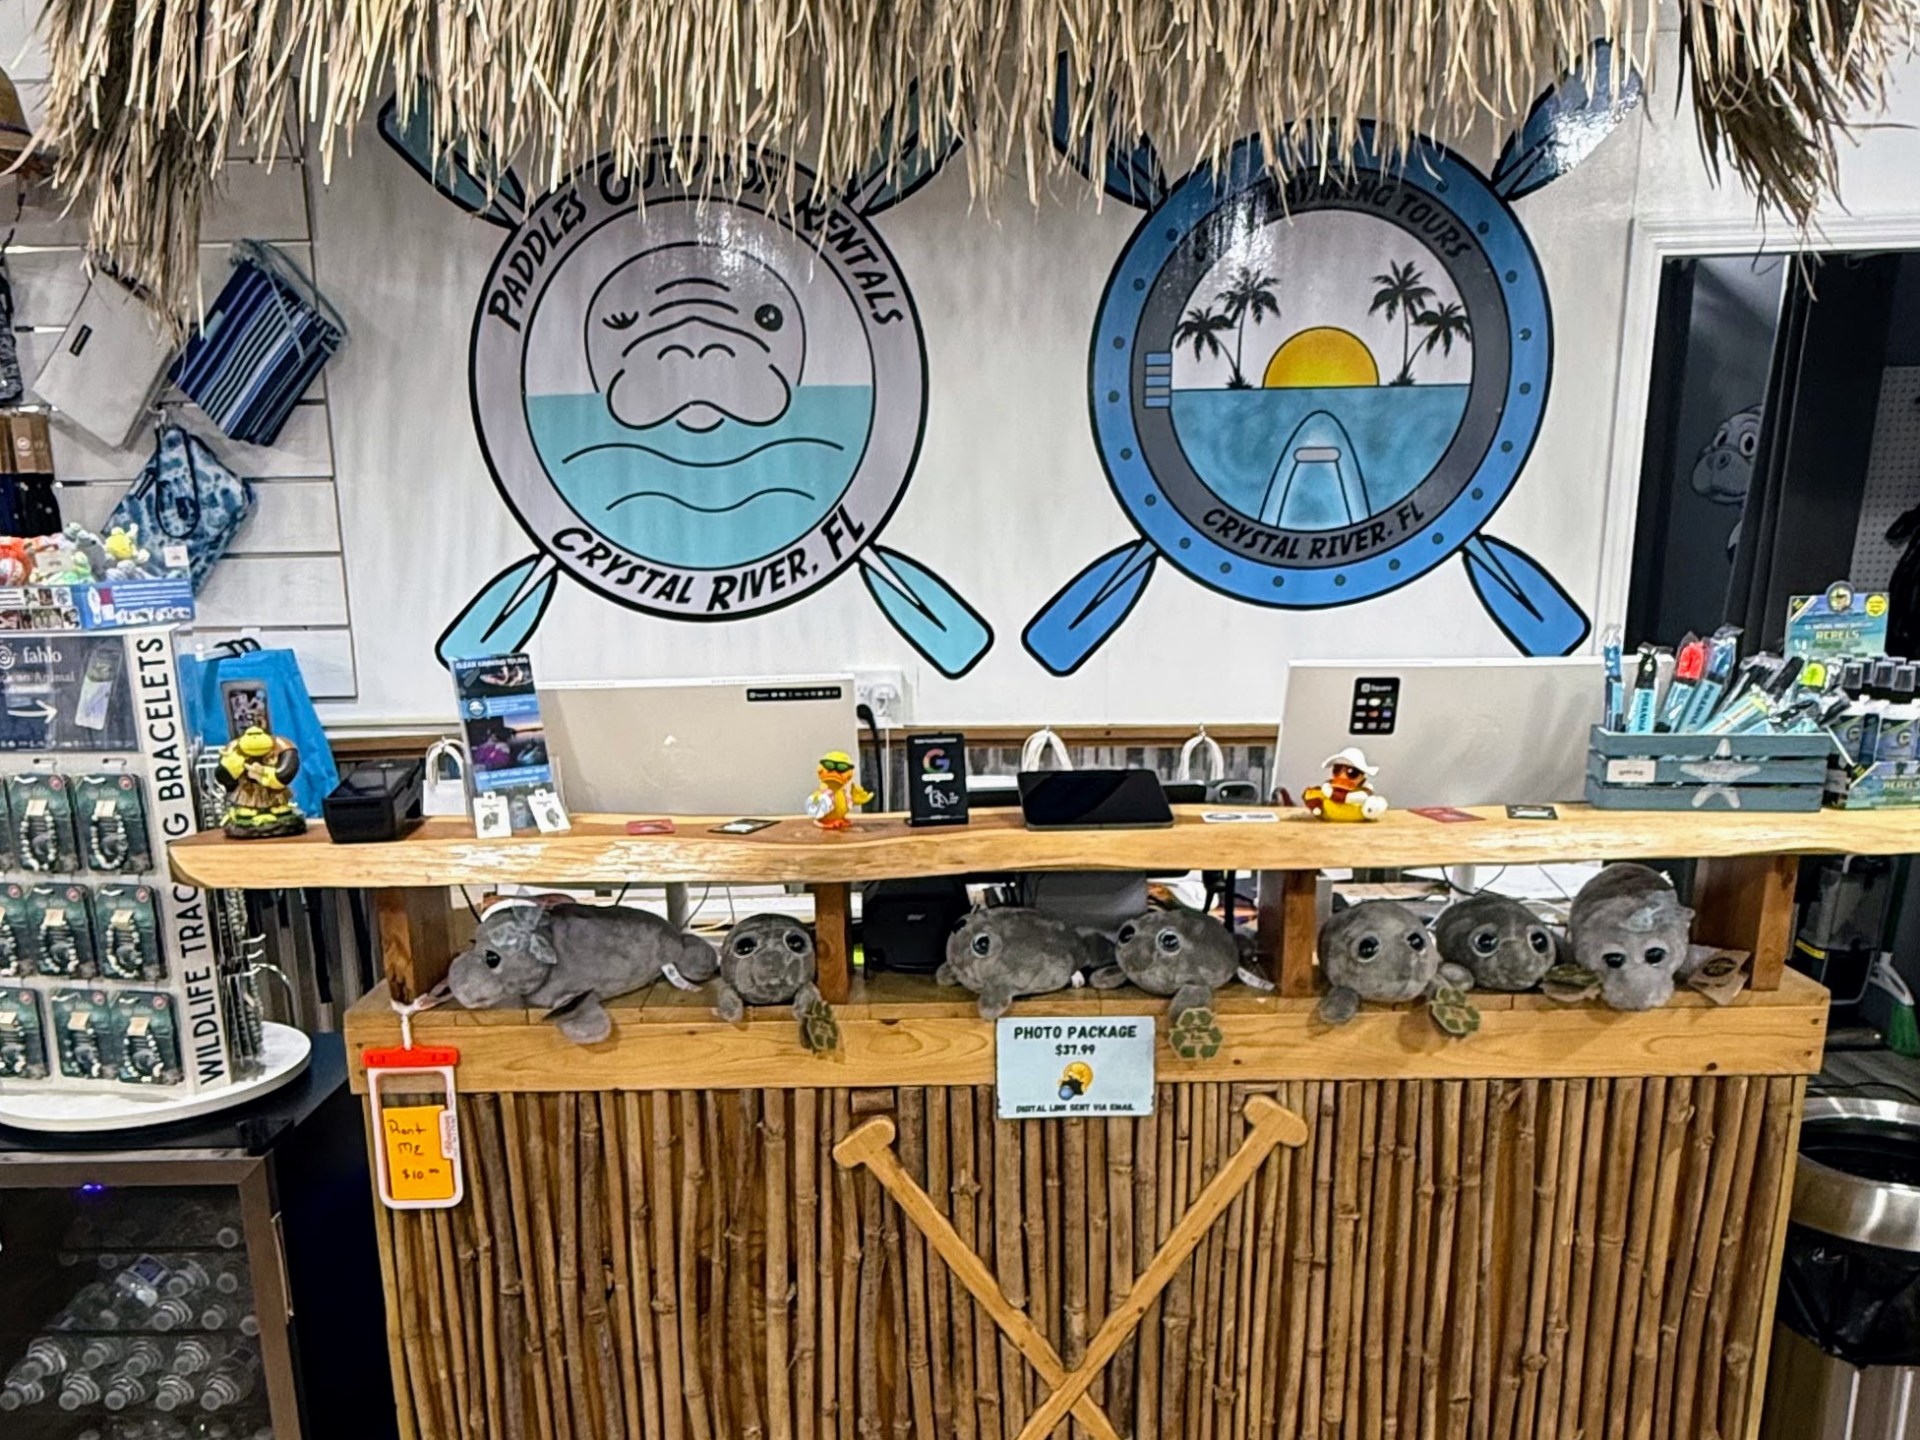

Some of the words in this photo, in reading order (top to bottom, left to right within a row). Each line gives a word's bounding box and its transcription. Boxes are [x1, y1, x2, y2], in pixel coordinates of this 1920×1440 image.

[1395, 192, 1473, 259] TOURS
[488, 189, 587, 333] PADDLES
[551, 527, 695, 605] CRYSTAL
[706, 547, 819, 612] RIVER,
[820, 503, 866, 561] FL
[1202, 508, 1299, 560] CRYSTAL
[1396, 501, 1425, 531] FL
[23, 646, 63, 664] fahlo
[34, 671, 76, 682] Animal
[136, 637, 186, 802] BRACELETS
[163, 812, 208, 959] TRACG
[184, 965, 224, 1086] WILDLIFE
[1014, 1026, 1063, 1040] PHOTO
[1067, 1025, 1138, 1039] PACKAGE
[1055, 1044, 1096, 1056] $37.99
[387, 1118, 428, 1135] Rent
[1016, 1104, 1047, 1113] DIGITAL
[1049, 1104, 1067, 1112] LINK
[1070, 1104, 1090, 1112] SENT
[1093, 1103, 1107, 1111] VIA
[1109, 1103, 1135, 1111] EMAIL
